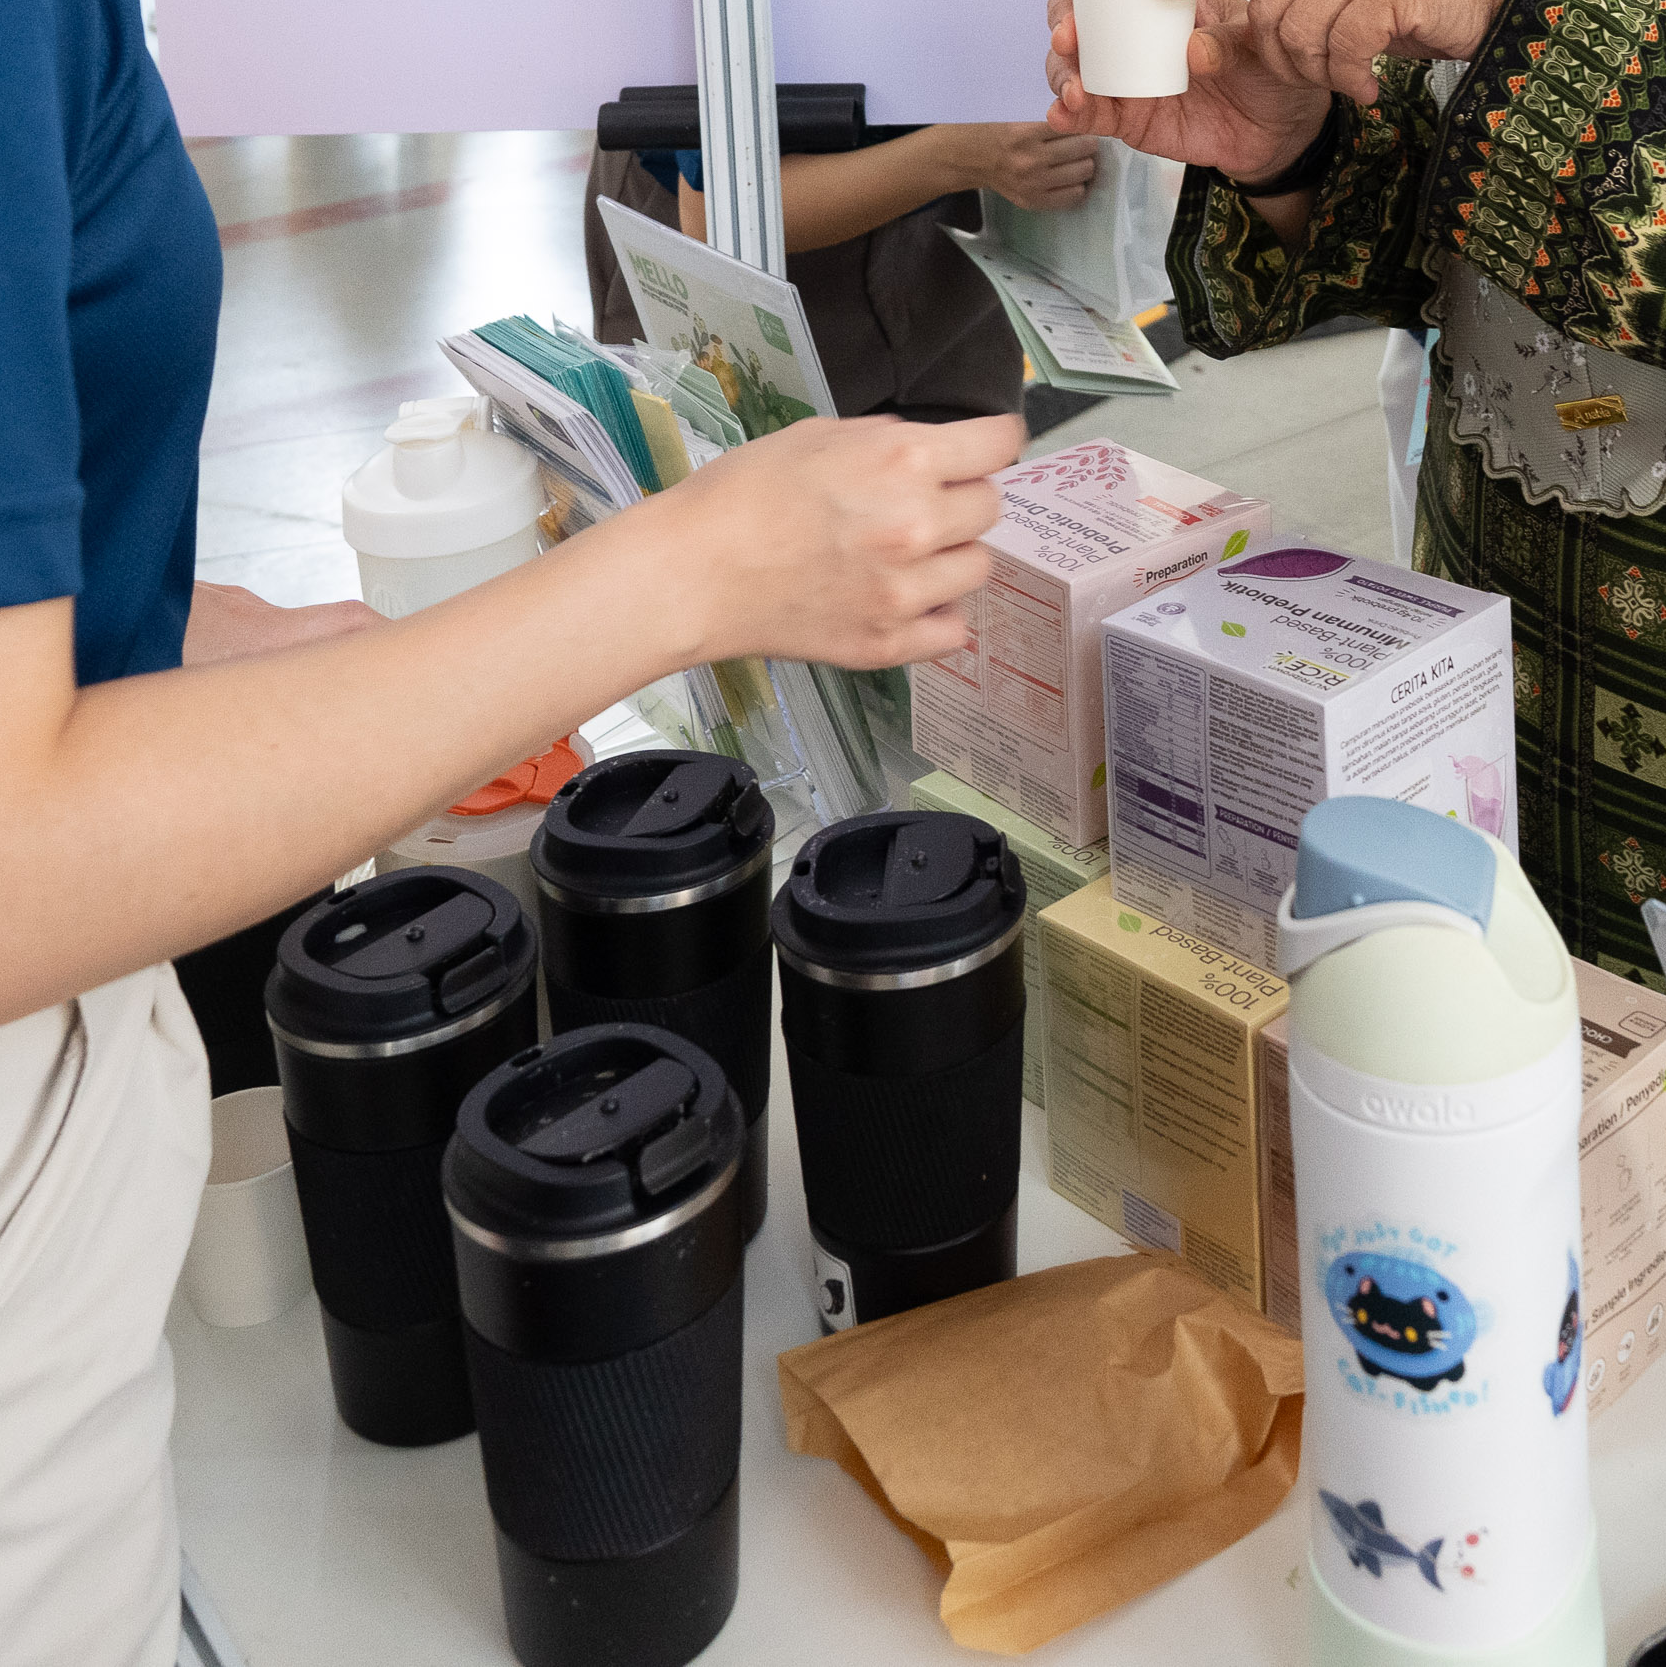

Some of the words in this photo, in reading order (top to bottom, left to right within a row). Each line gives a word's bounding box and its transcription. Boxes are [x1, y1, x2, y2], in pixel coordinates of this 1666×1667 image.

[1045, 510, 1131, 556] Prebiotic
[1033, 544, 1085, 574] 100%
[1144, 549, 1210, 585] Preparation
[1220, 580, 1309, 618] Prebiotik
[1270, 614, 1395, 662] Plant-Based
[1311, 613, 1412, 651] Minuman
[1284, 659, 1348, 688] RICE
[1320, 646, 1376, 672] 100%
[1391, 671, 1428, 704] CERITA
[1431, 655, 1454, 681] KITA
[1371, 708, 1398, 731] minuman
[1148, 924, 1285, 998] Plant-Based
[1197, 972, 1260, 1011] 100%
[1361, 1092, 1477, 1128] owala
[1579, 1113, 1619, 1151] aration
[1591, 1285, 1628, 1324] Simple
